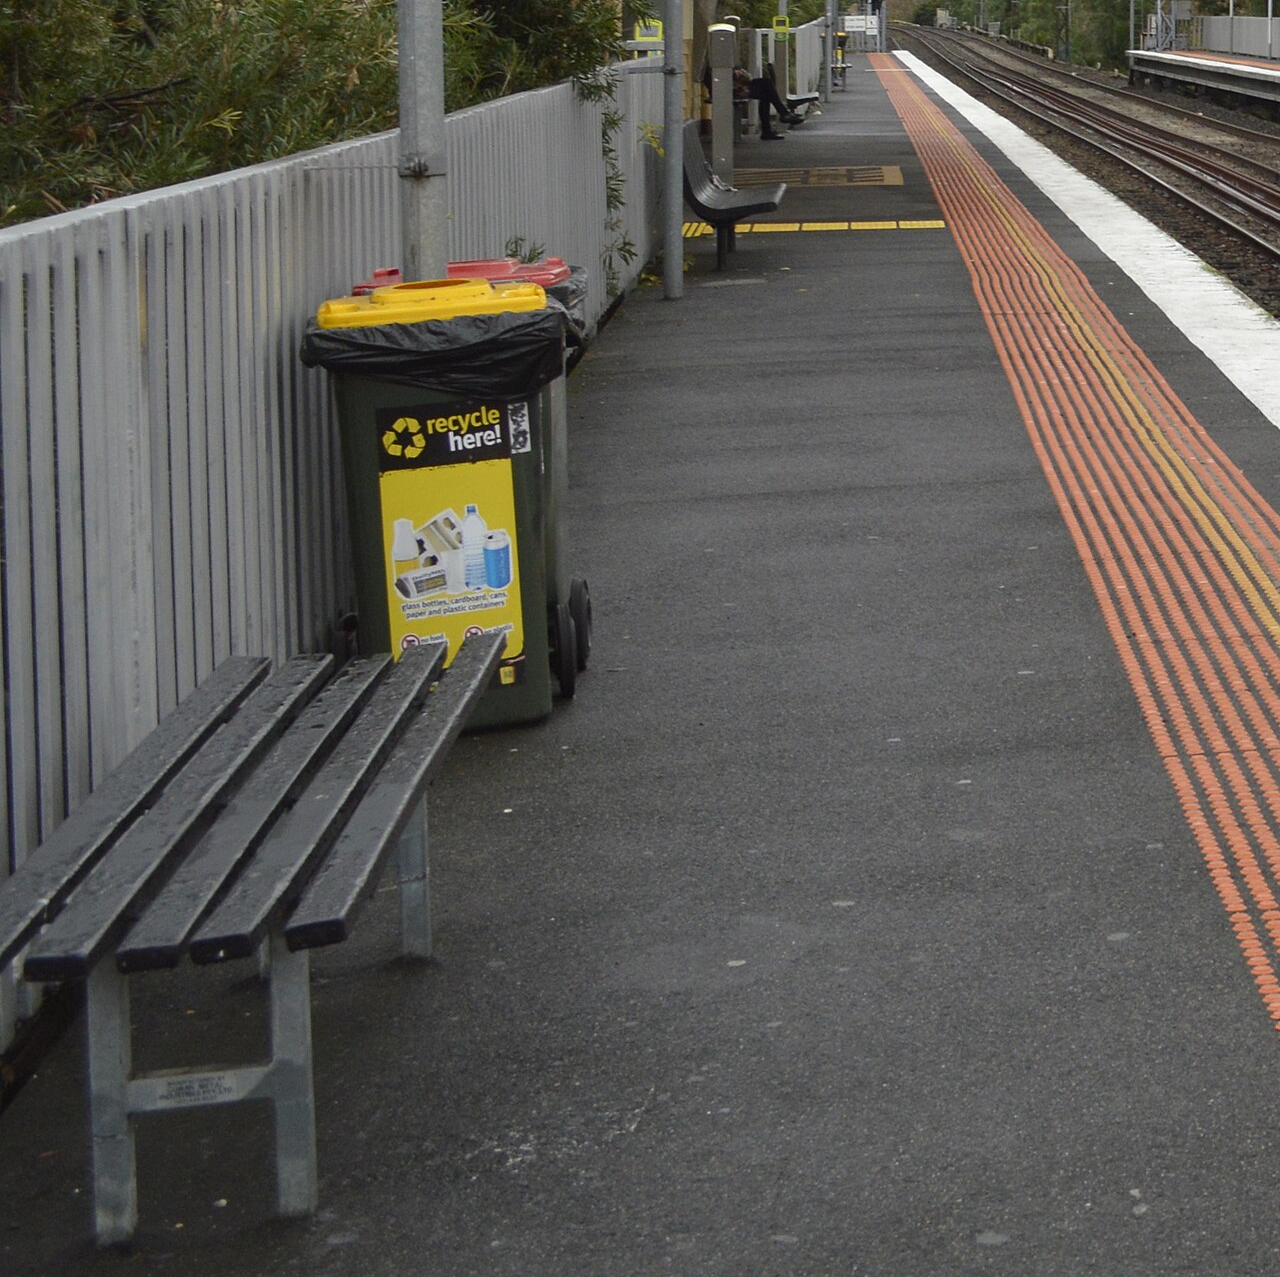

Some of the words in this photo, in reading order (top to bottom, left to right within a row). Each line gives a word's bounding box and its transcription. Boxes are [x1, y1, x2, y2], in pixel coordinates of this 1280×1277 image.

[426, 406, 501, 435] recycle
[448, 424, 503, 452] here!
[402, 603, 421, 613] glass
[422, 599, 450, 608] bottles,
[450, 595, 488, 604] cardboard,
[406, 611, 427, 620] paper
[428, 608, 442, 616] and
[443, 604, 467, 614] plastic
[468, 600, 505, 610] containers
